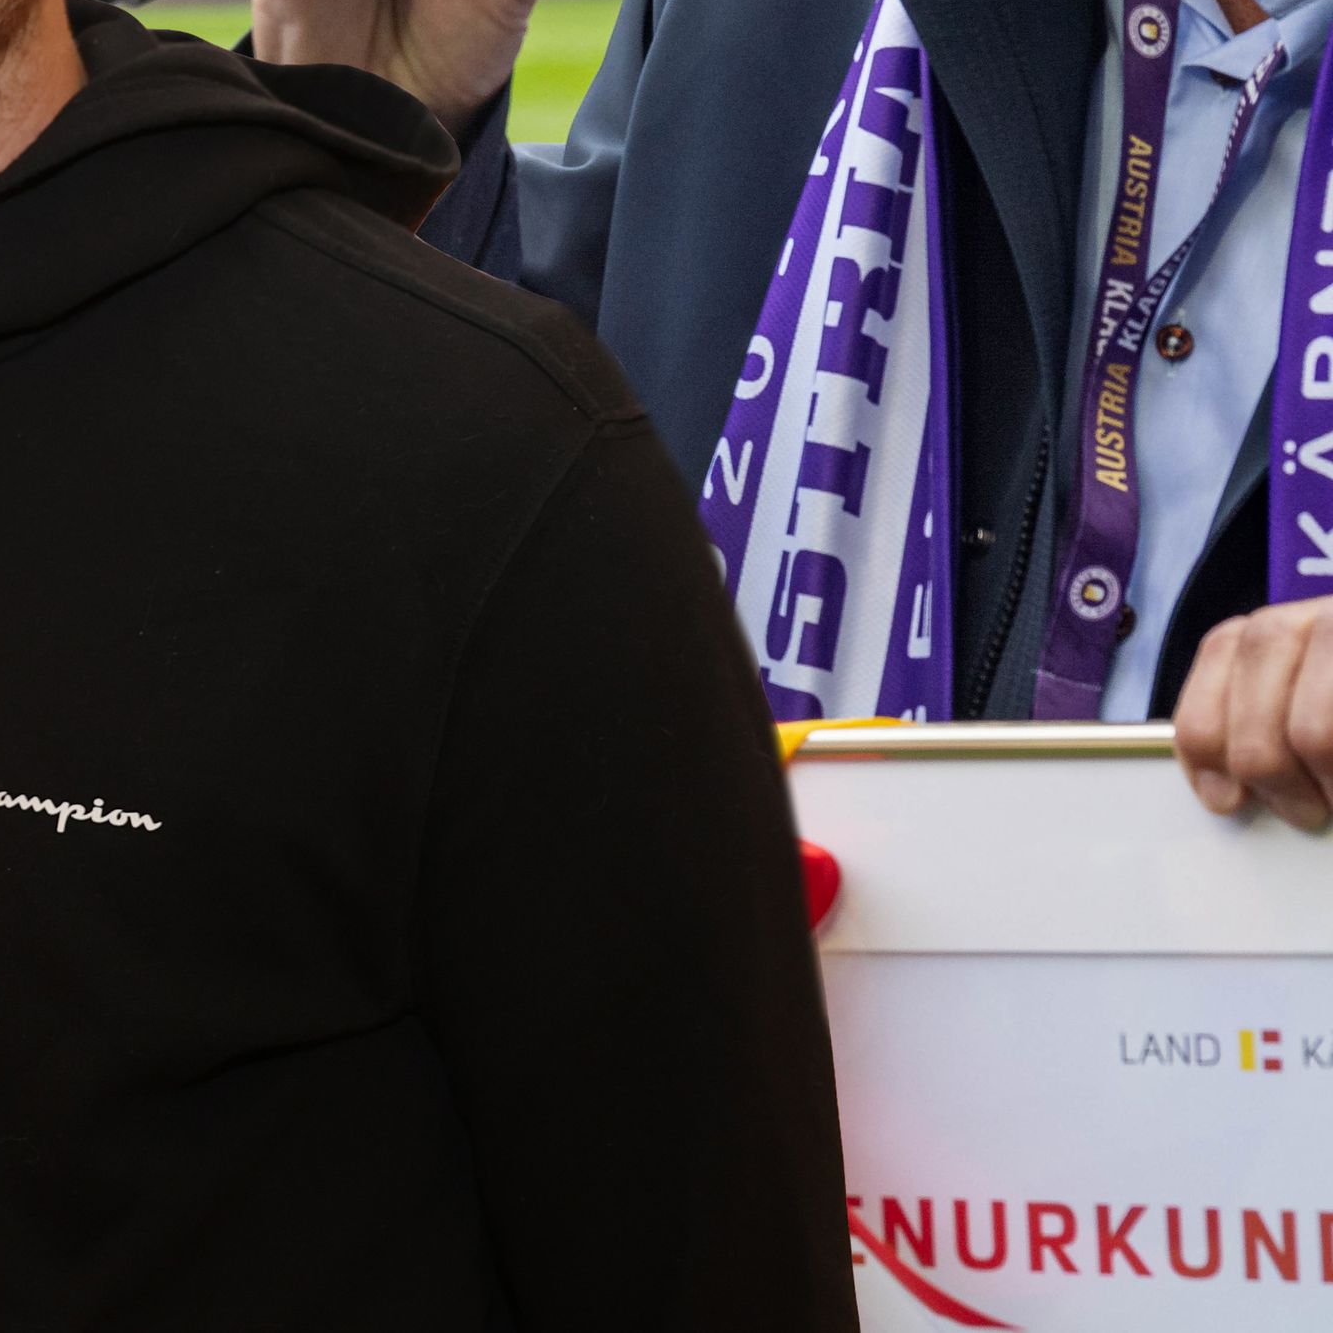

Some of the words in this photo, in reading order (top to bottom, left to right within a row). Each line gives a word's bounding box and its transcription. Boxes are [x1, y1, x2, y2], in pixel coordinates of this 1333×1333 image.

[1110, 134, 1153, 266] AUSTRIA
[1095, 363, 1131, 493] AUSTRIA
[1119, 1032, 1222, 1067] LAND
[846, 1194, 1333, 1284] NURKUN
